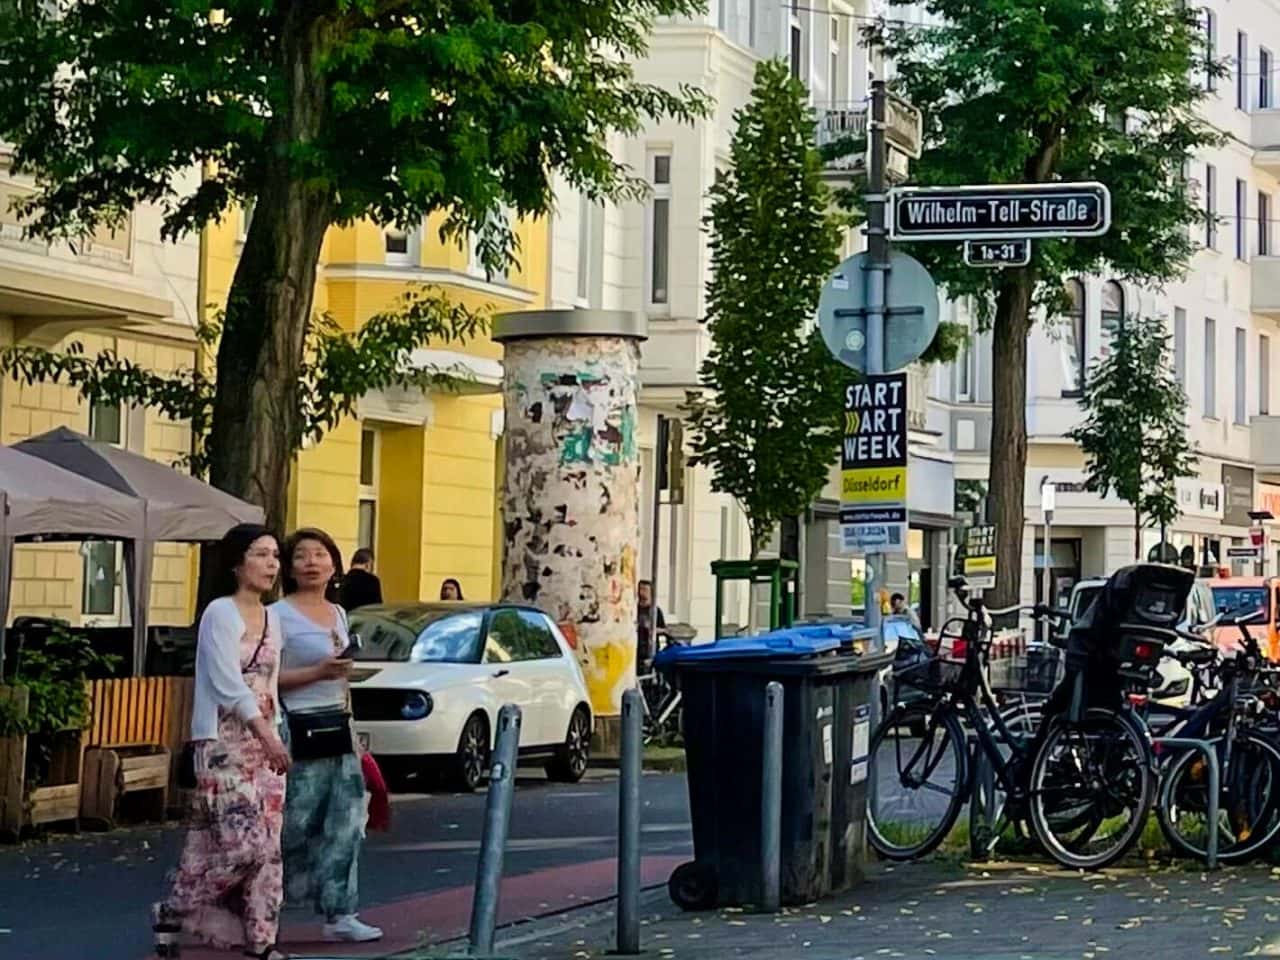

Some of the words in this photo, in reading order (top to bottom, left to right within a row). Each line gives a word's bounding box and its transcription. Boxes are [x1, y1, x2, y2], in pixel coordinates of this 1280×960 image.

[907, 198, 1088, 224] Wilhelm-Tell-Straße
[981, 244, 1015, 260] 1a-31
[845, 381, 902, 409] START
[860, 409, 902, 433] ART
[844, 435, 902, 461] WEEK
[843, 474, 901, 494] Düsseldorf
